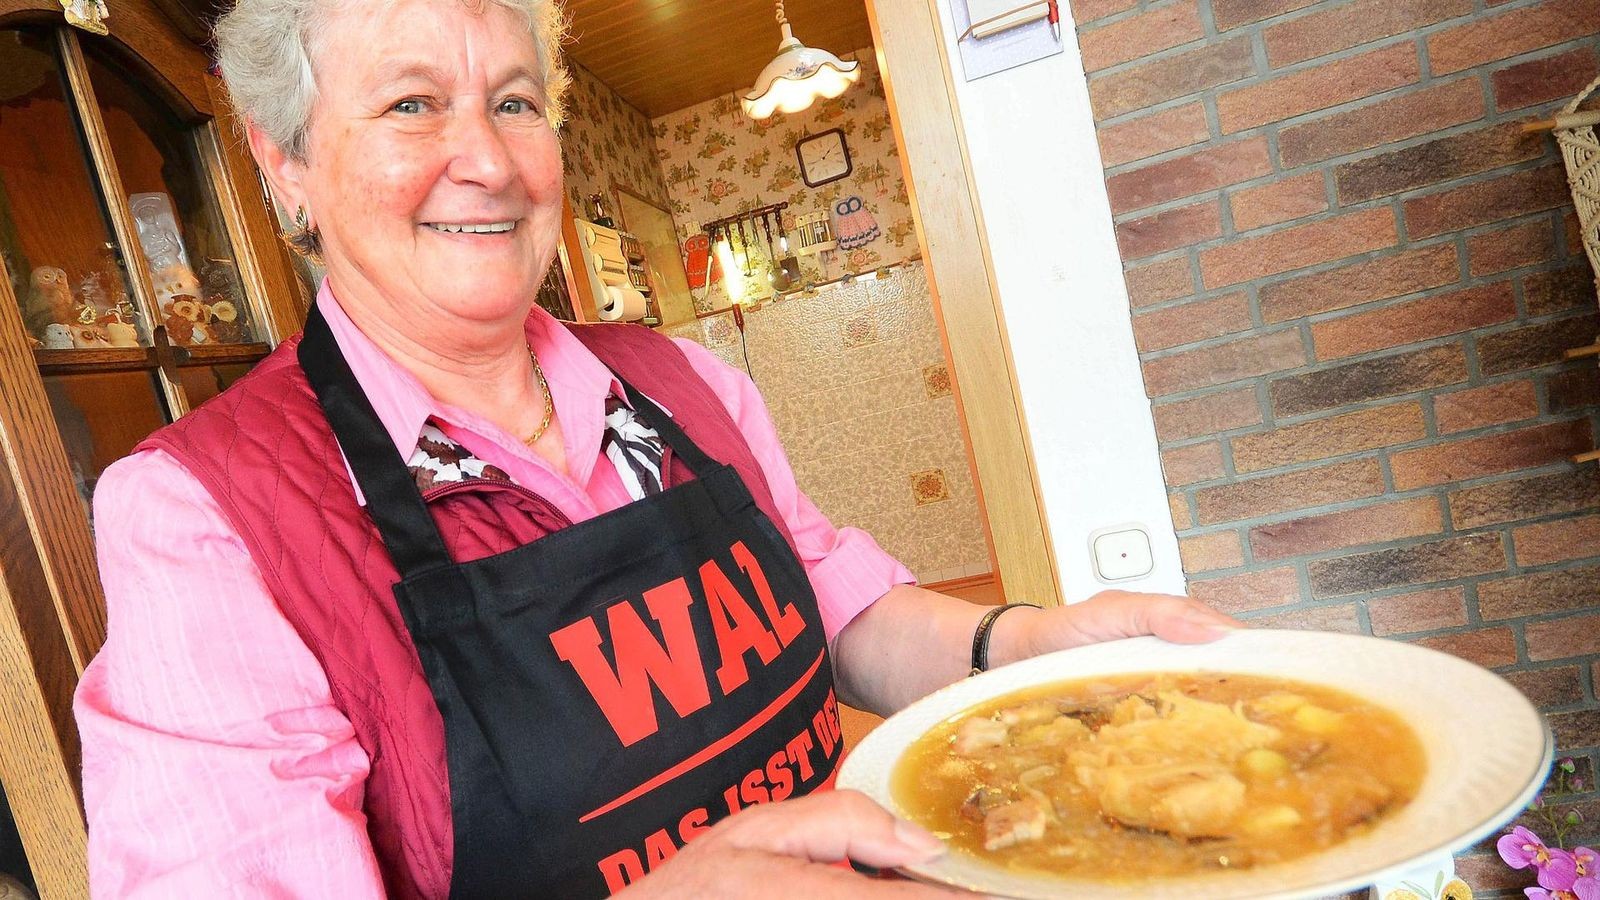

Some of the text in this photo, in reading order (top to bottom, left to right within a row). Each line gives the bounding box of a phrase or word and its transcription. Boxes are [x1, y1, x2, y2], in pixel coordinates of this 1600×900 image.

[549, 540, 806, 747] WAL
[597, 687, 841, 896] DAS ISST DE
